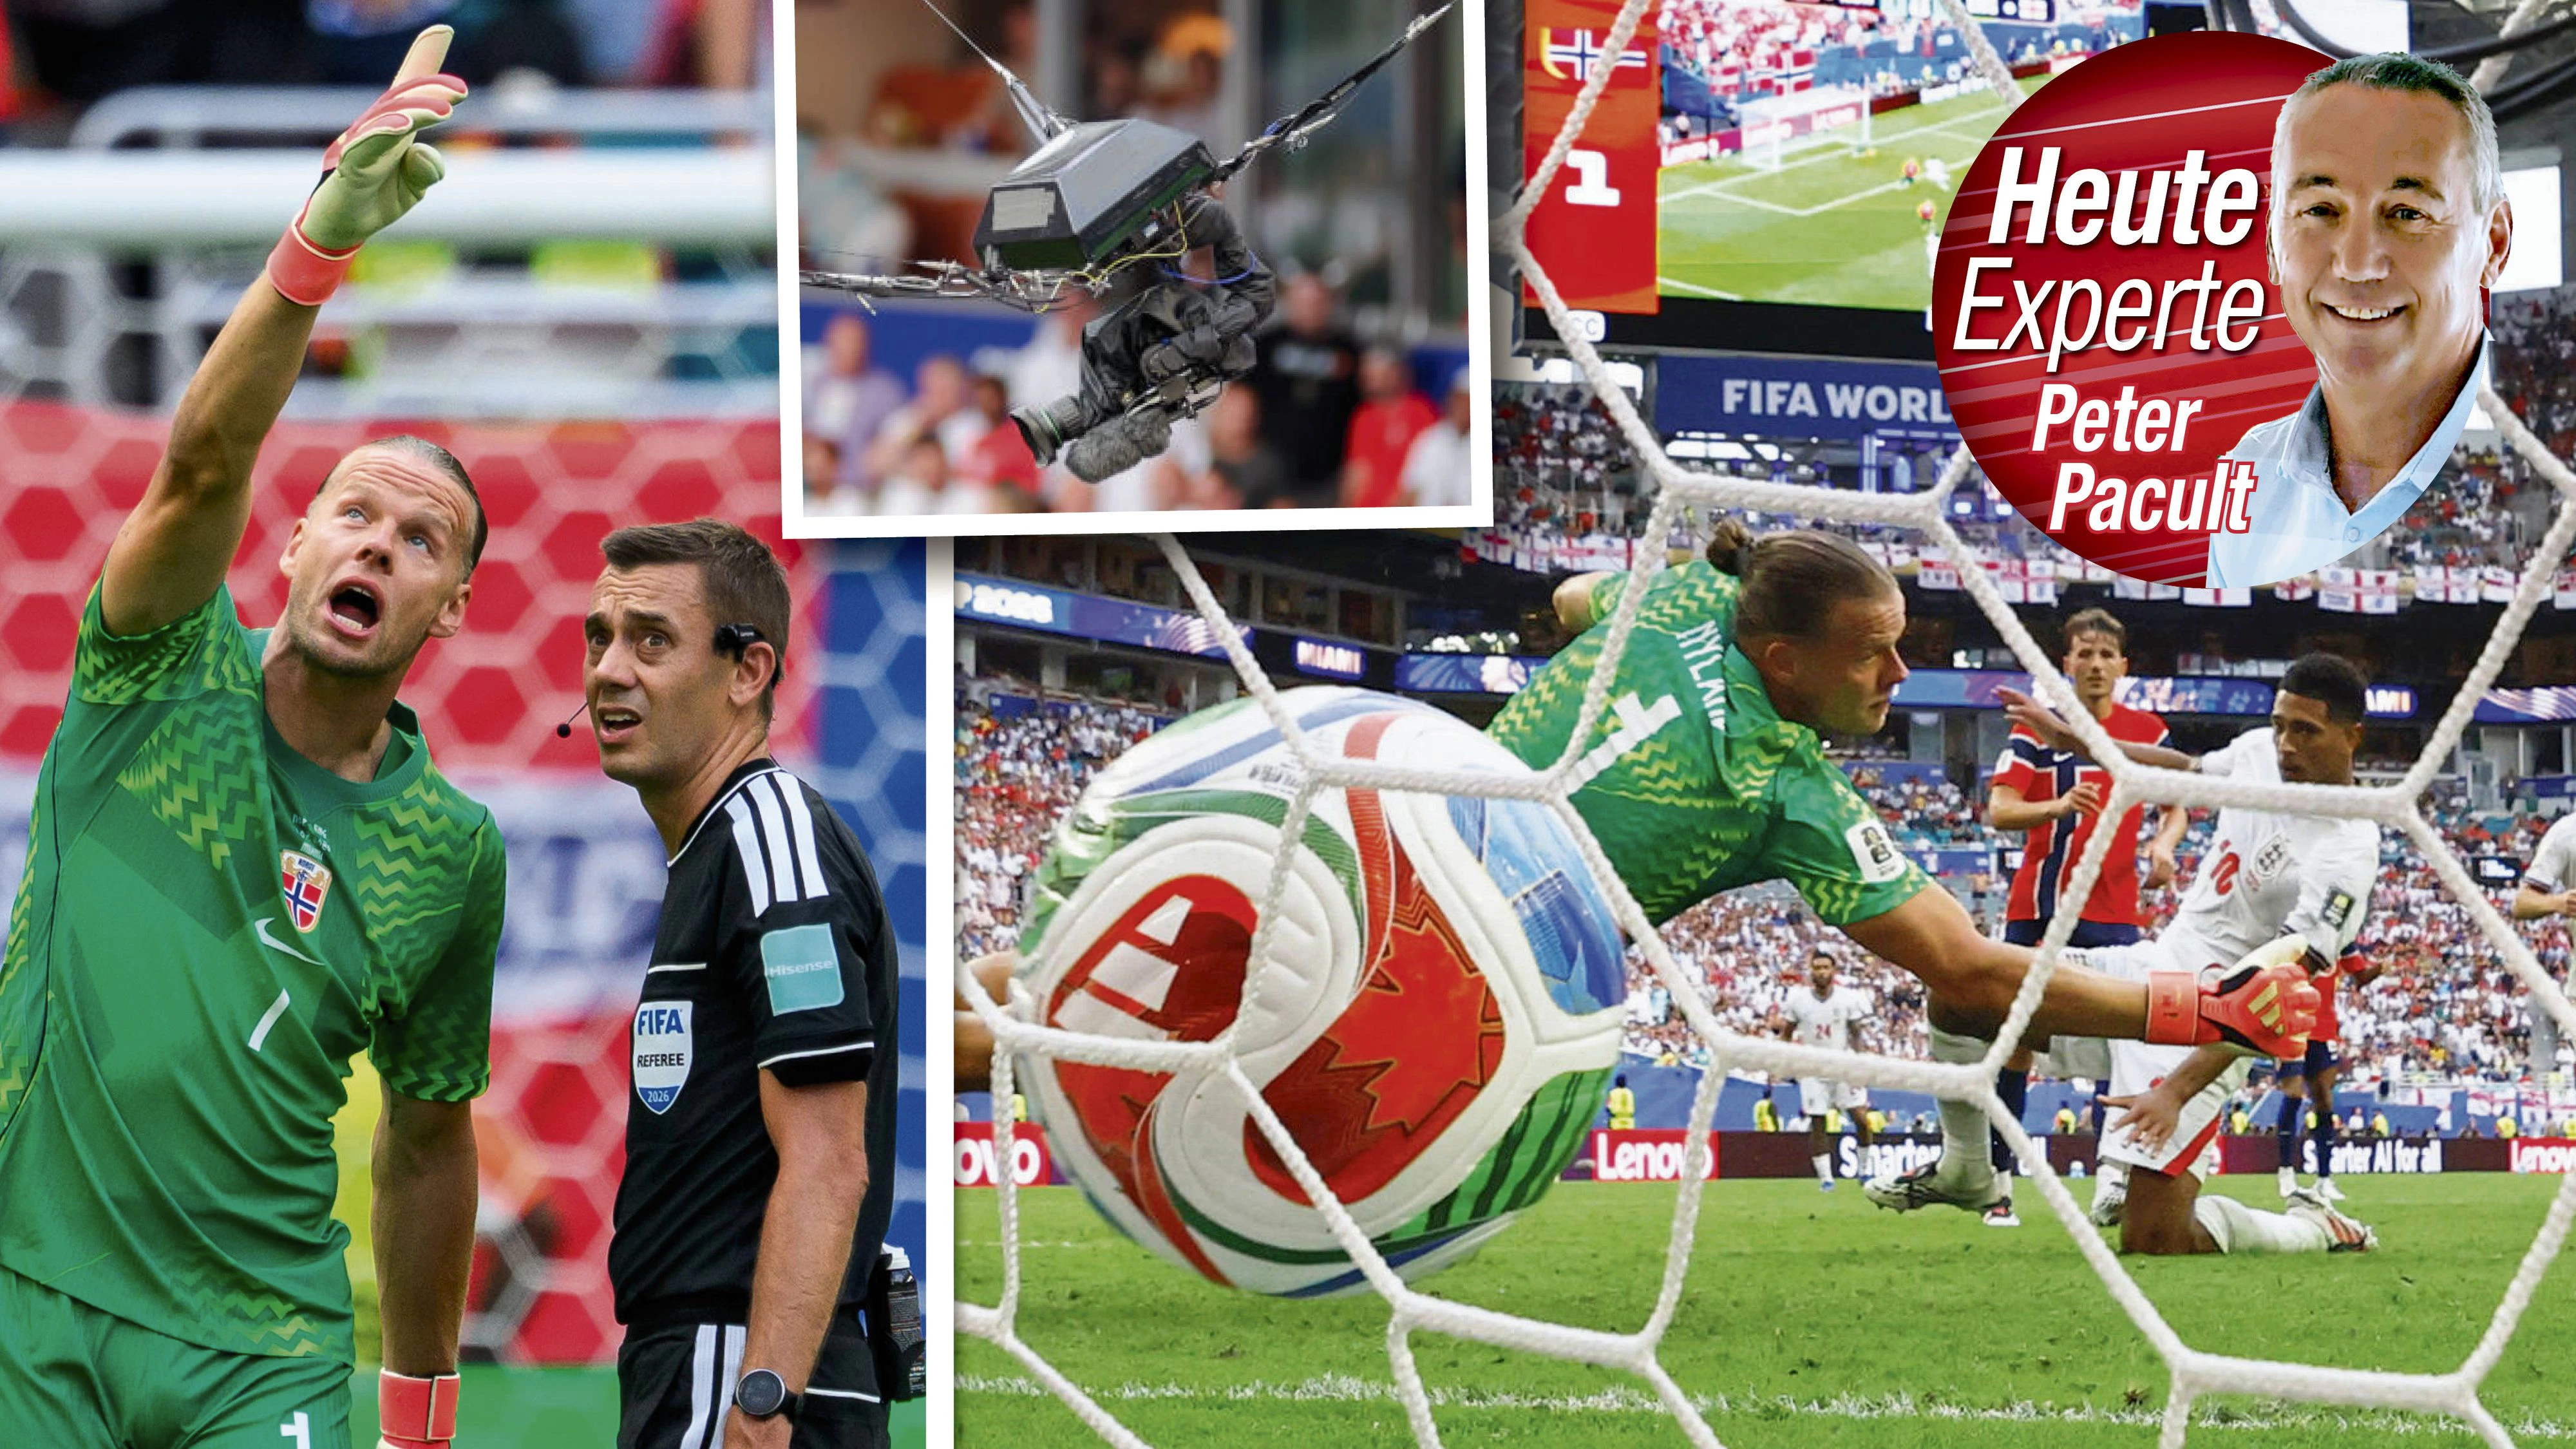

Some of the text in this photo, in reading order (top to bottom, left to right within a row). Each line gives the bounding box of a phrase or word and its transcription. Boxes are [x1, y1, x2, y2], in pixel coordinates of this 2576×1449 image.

[1566, 149, 1620, 207] 1
[1723, 379, 1954, 423] FIFA WORL
[1297, 640, 1361, 674] MIAMI
[1566, 690, 1683, 794] 1
[770, 960, 834, 978] Hisense
[638, 1009, 685, 1036] FIFA
[638, 1053, 685, 1068] REFEREE
[647, 1090, 670, 1103] 2026
[2303, 1139, 2372, 1173] Sarter
